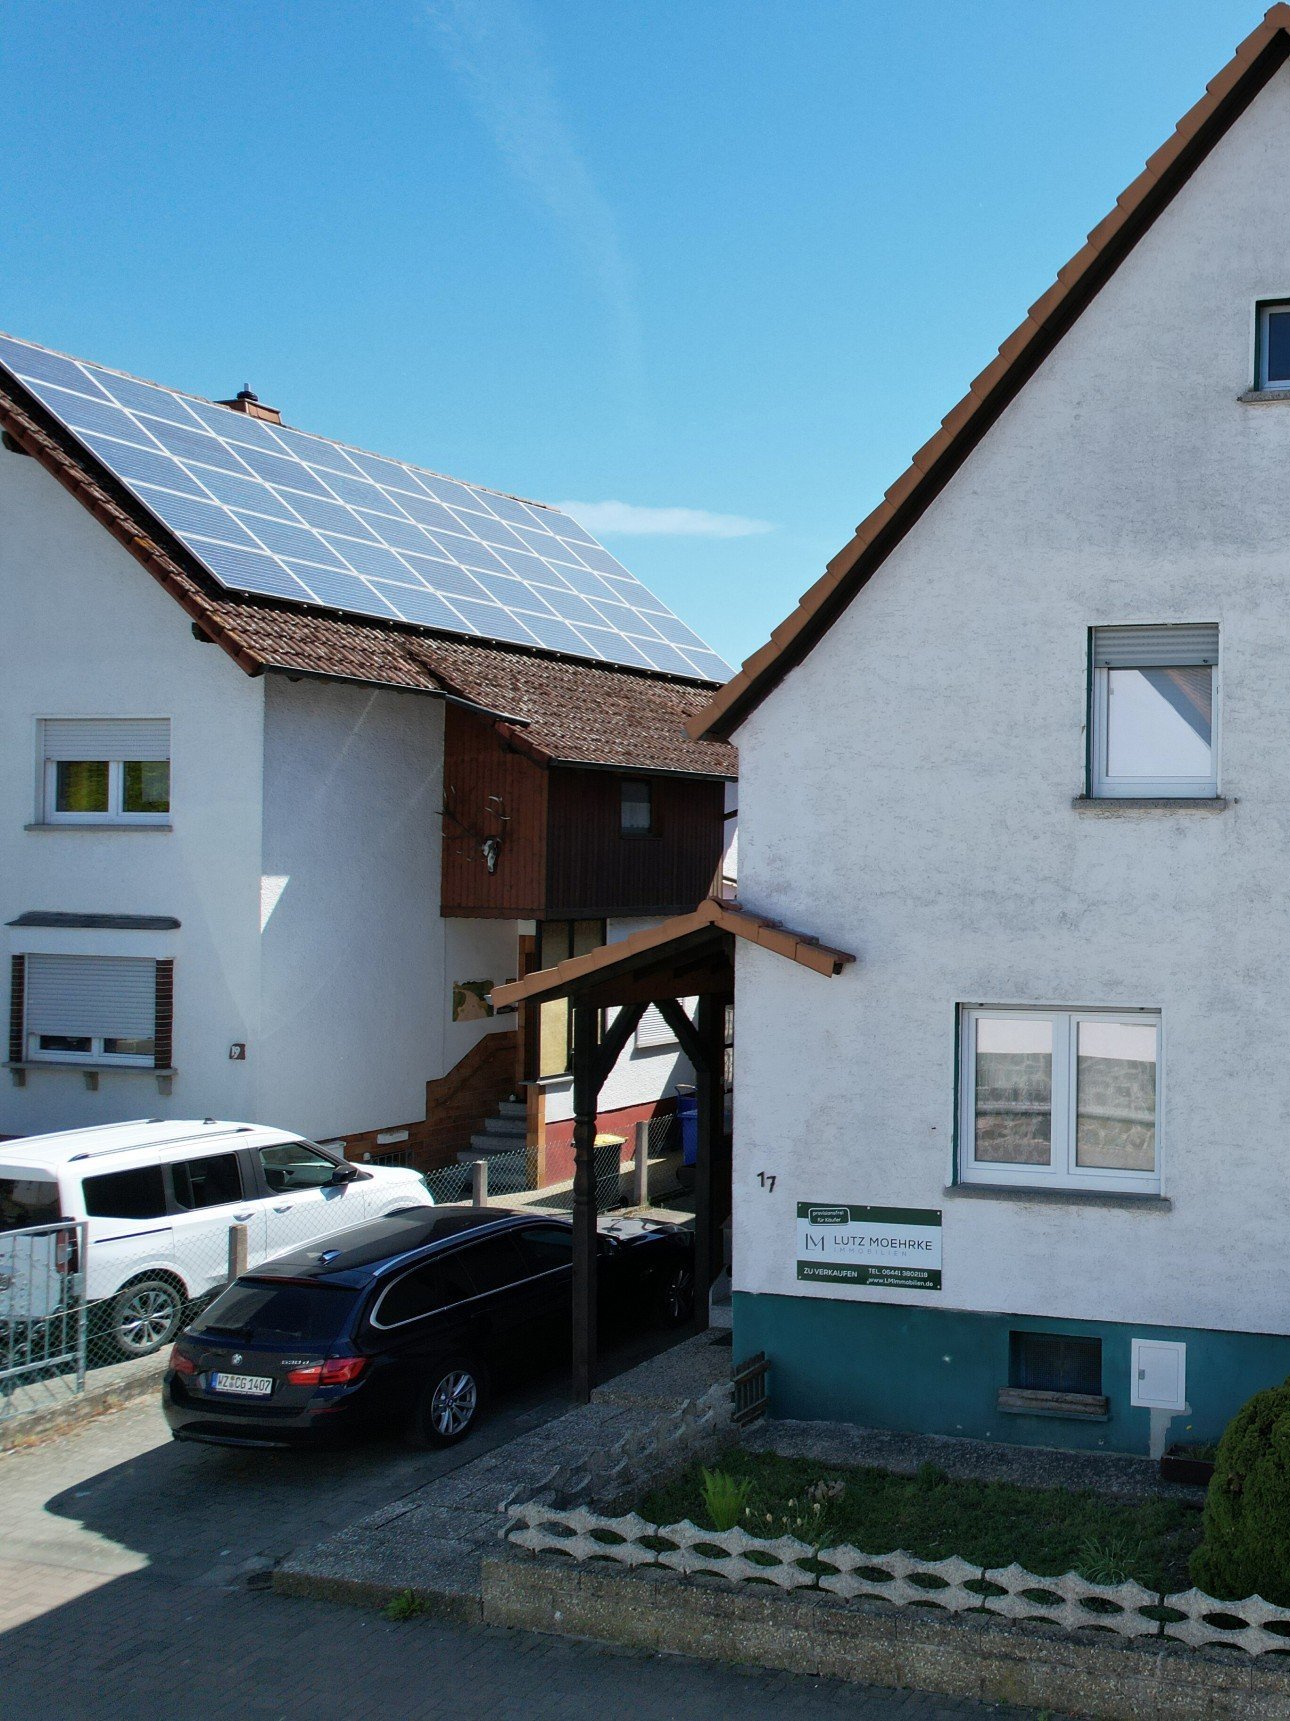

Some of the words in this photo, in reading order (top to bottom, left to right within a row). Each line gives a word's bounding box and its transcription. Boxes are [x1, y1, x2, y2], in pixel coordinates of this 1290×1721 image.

[756, 1170, 776, 1193] 17
[834, 1235, 865, 1247] LUTZ
[869, 1237, 933, 1251] MOEHRKE
[834, 1247, 907, 1257] IMMOBILIEN
[803, 1267, 814, 1275] ZU
[814, 1268, 858, 1278] VERKAUFEN
[218, 1374, 229, 1388] WZ
[235, 1376, 247, 1390] CG
[248, 1378, 271, 1392] 1407
